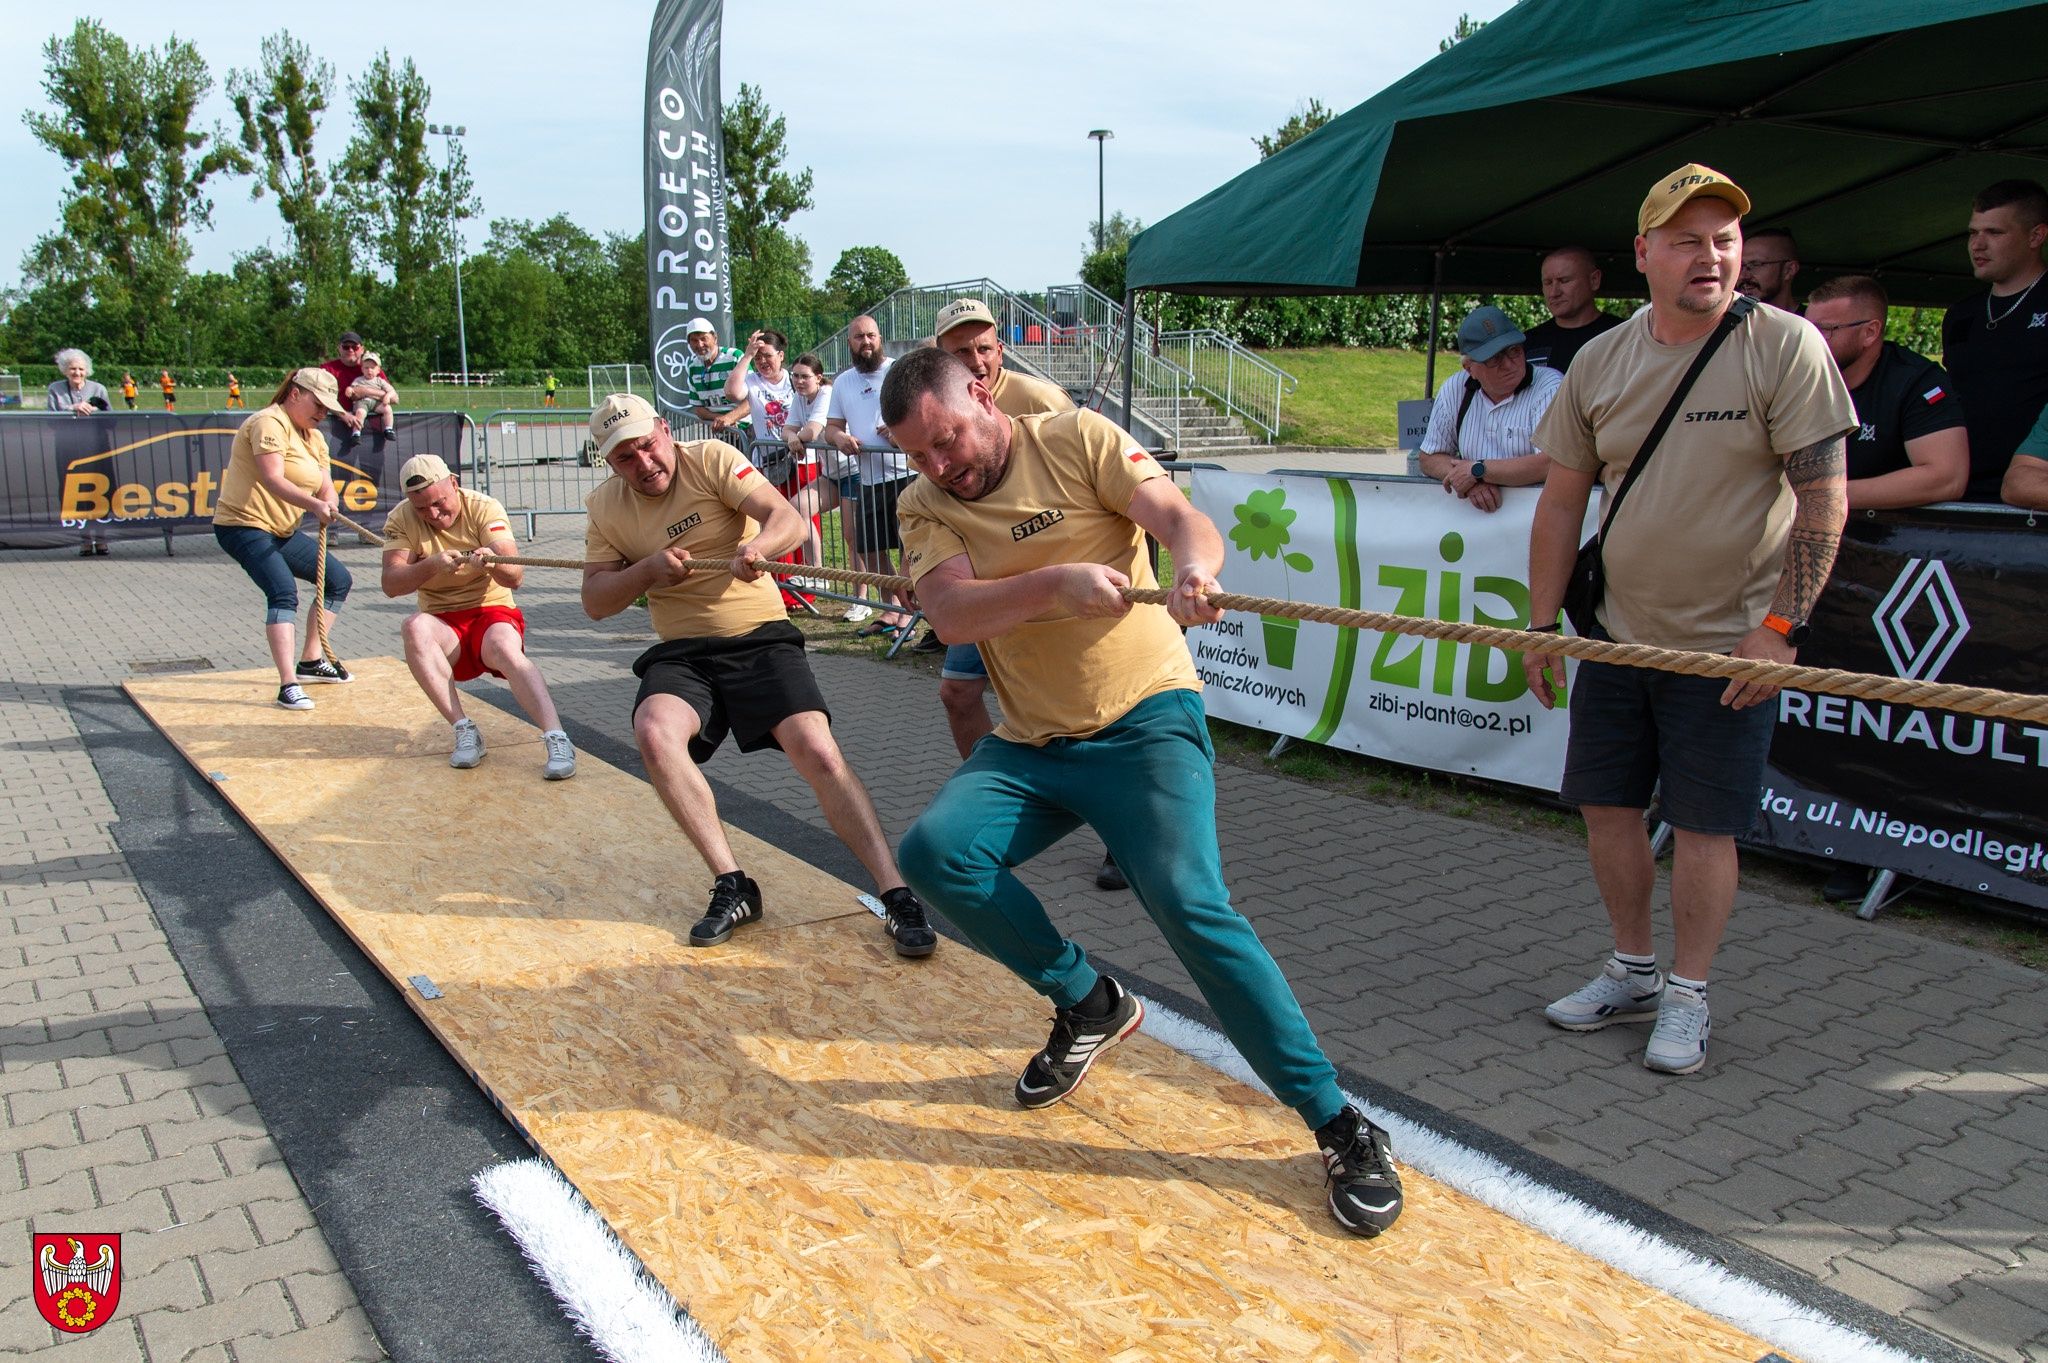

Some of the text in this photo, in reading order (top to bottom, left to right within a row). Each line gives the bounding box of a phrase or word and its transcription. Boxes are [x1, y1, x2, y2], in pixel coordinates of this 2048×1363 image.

[657, 87, 688, 310] PROECO
[1668, 174, 1722, 195] STRA
[691, 130, 718, 312] GROWTH
[720, 239, 732, 314] NAWOZY
[61, 469, 379, 520] Beste
[1196, 640, 1259, 670] kwiatów
[1196, 665, 1306, 708] doniczkowych
[1369, 692, 1532, 736] zibi-plant@o2.pl
[1778, 688, 2048, 768] RENAULT
[1760, 786, 1798, 822] ła,
[1805, 801, 1842, 828] ul.
